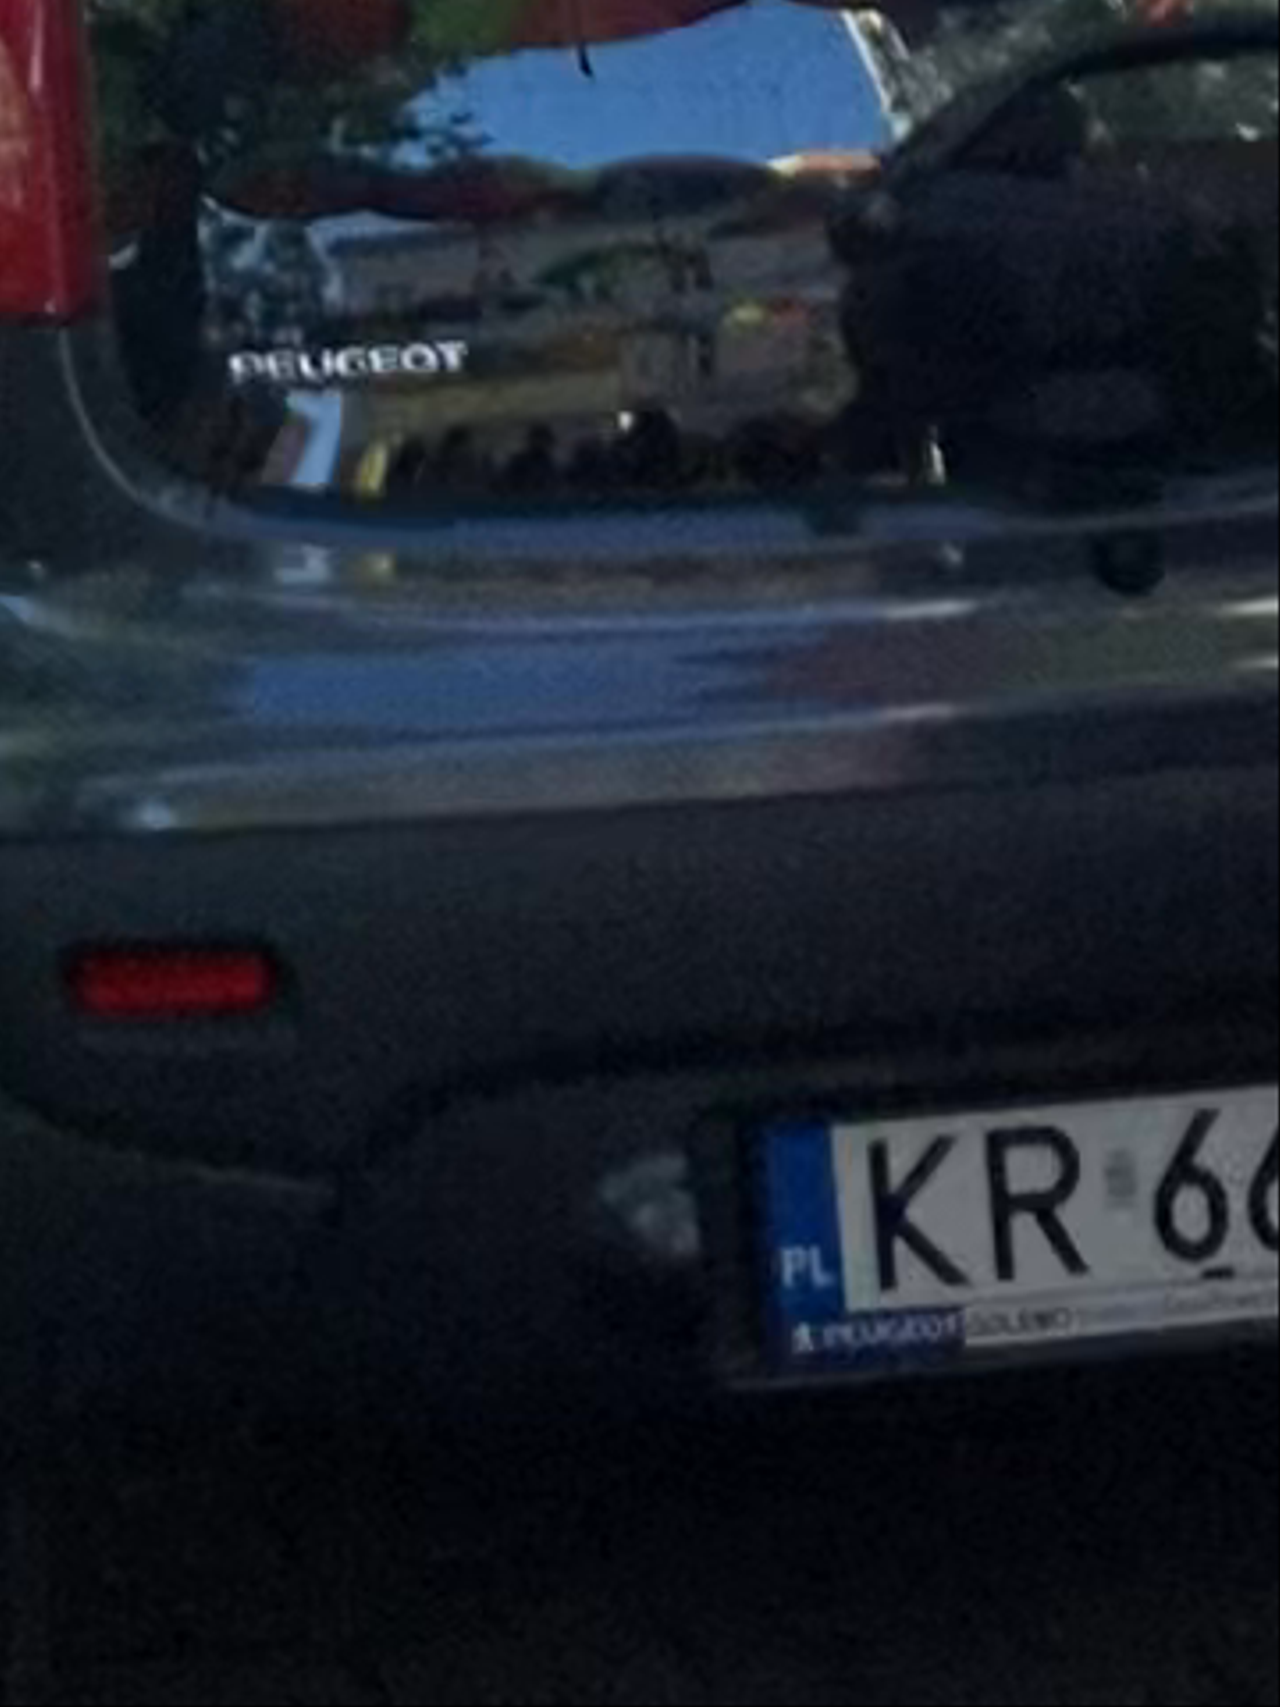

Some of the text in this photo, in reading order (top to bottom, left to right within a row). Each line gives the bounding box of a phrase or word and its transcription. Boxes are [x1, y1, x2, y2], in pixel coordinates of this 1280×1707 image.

[228, 340, 468, 383] PEUGEOT
[867, 1125, 1091, 1291] KR
[779, 1245, 833, 1289] PL
